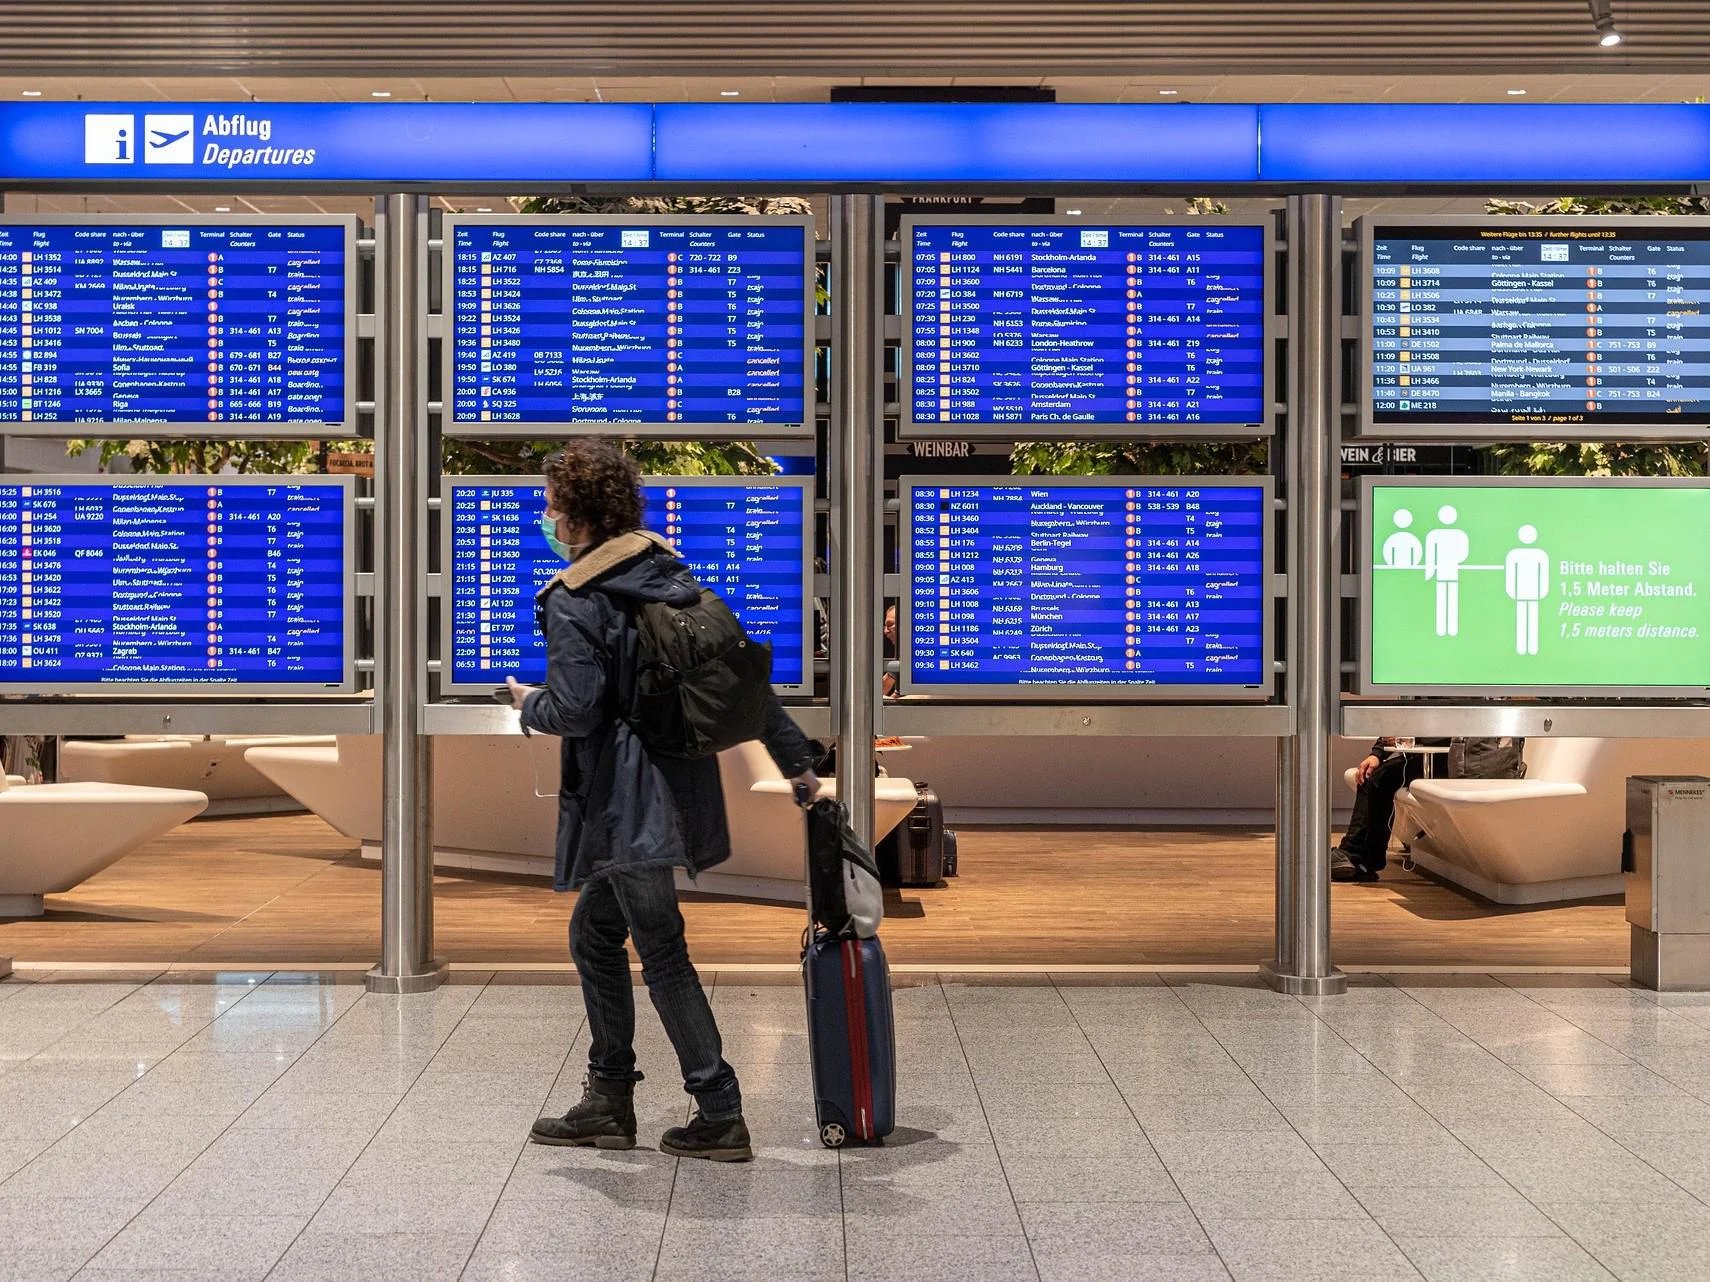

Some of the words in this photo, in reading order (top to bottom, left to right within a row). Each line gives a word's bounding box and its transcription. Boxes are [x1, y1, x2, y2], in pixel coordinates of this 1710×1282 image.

[202, 114, 271, 140] Abflug
[202, 143, 315, 168] Departures
[1491, 280, 1524, 288] Göttingen
[1377, 341, 1395, 349] 11:00
[113, 401, 128, 410] Riga
[914, 442, 969, 457] WEINBAR
[1031, 540, 1071, 548] Berlin-Tegel
[1031, 564, 1063, 572] Hamburg
[1560, 561, 1593, 575] Bitte
[1599, 561, 1643, 575] halten
[1648, 561, 1670, 575] Sie
[1560, 582, 1581, 598] 1,5
[1588, 582, 1629, 598] Meter
[1634, 582, 1696, 598] Abstand.
[1559, 603, 1604, 619] Please
[1609, 603, 1642, 619] keep
[1560, 623, 1580, 639] 1,5
[1585, 623, 1632, 639] meters
[1637, 623, 1699, 639] distance.
[113, 647, 137, 657] Zagreb
